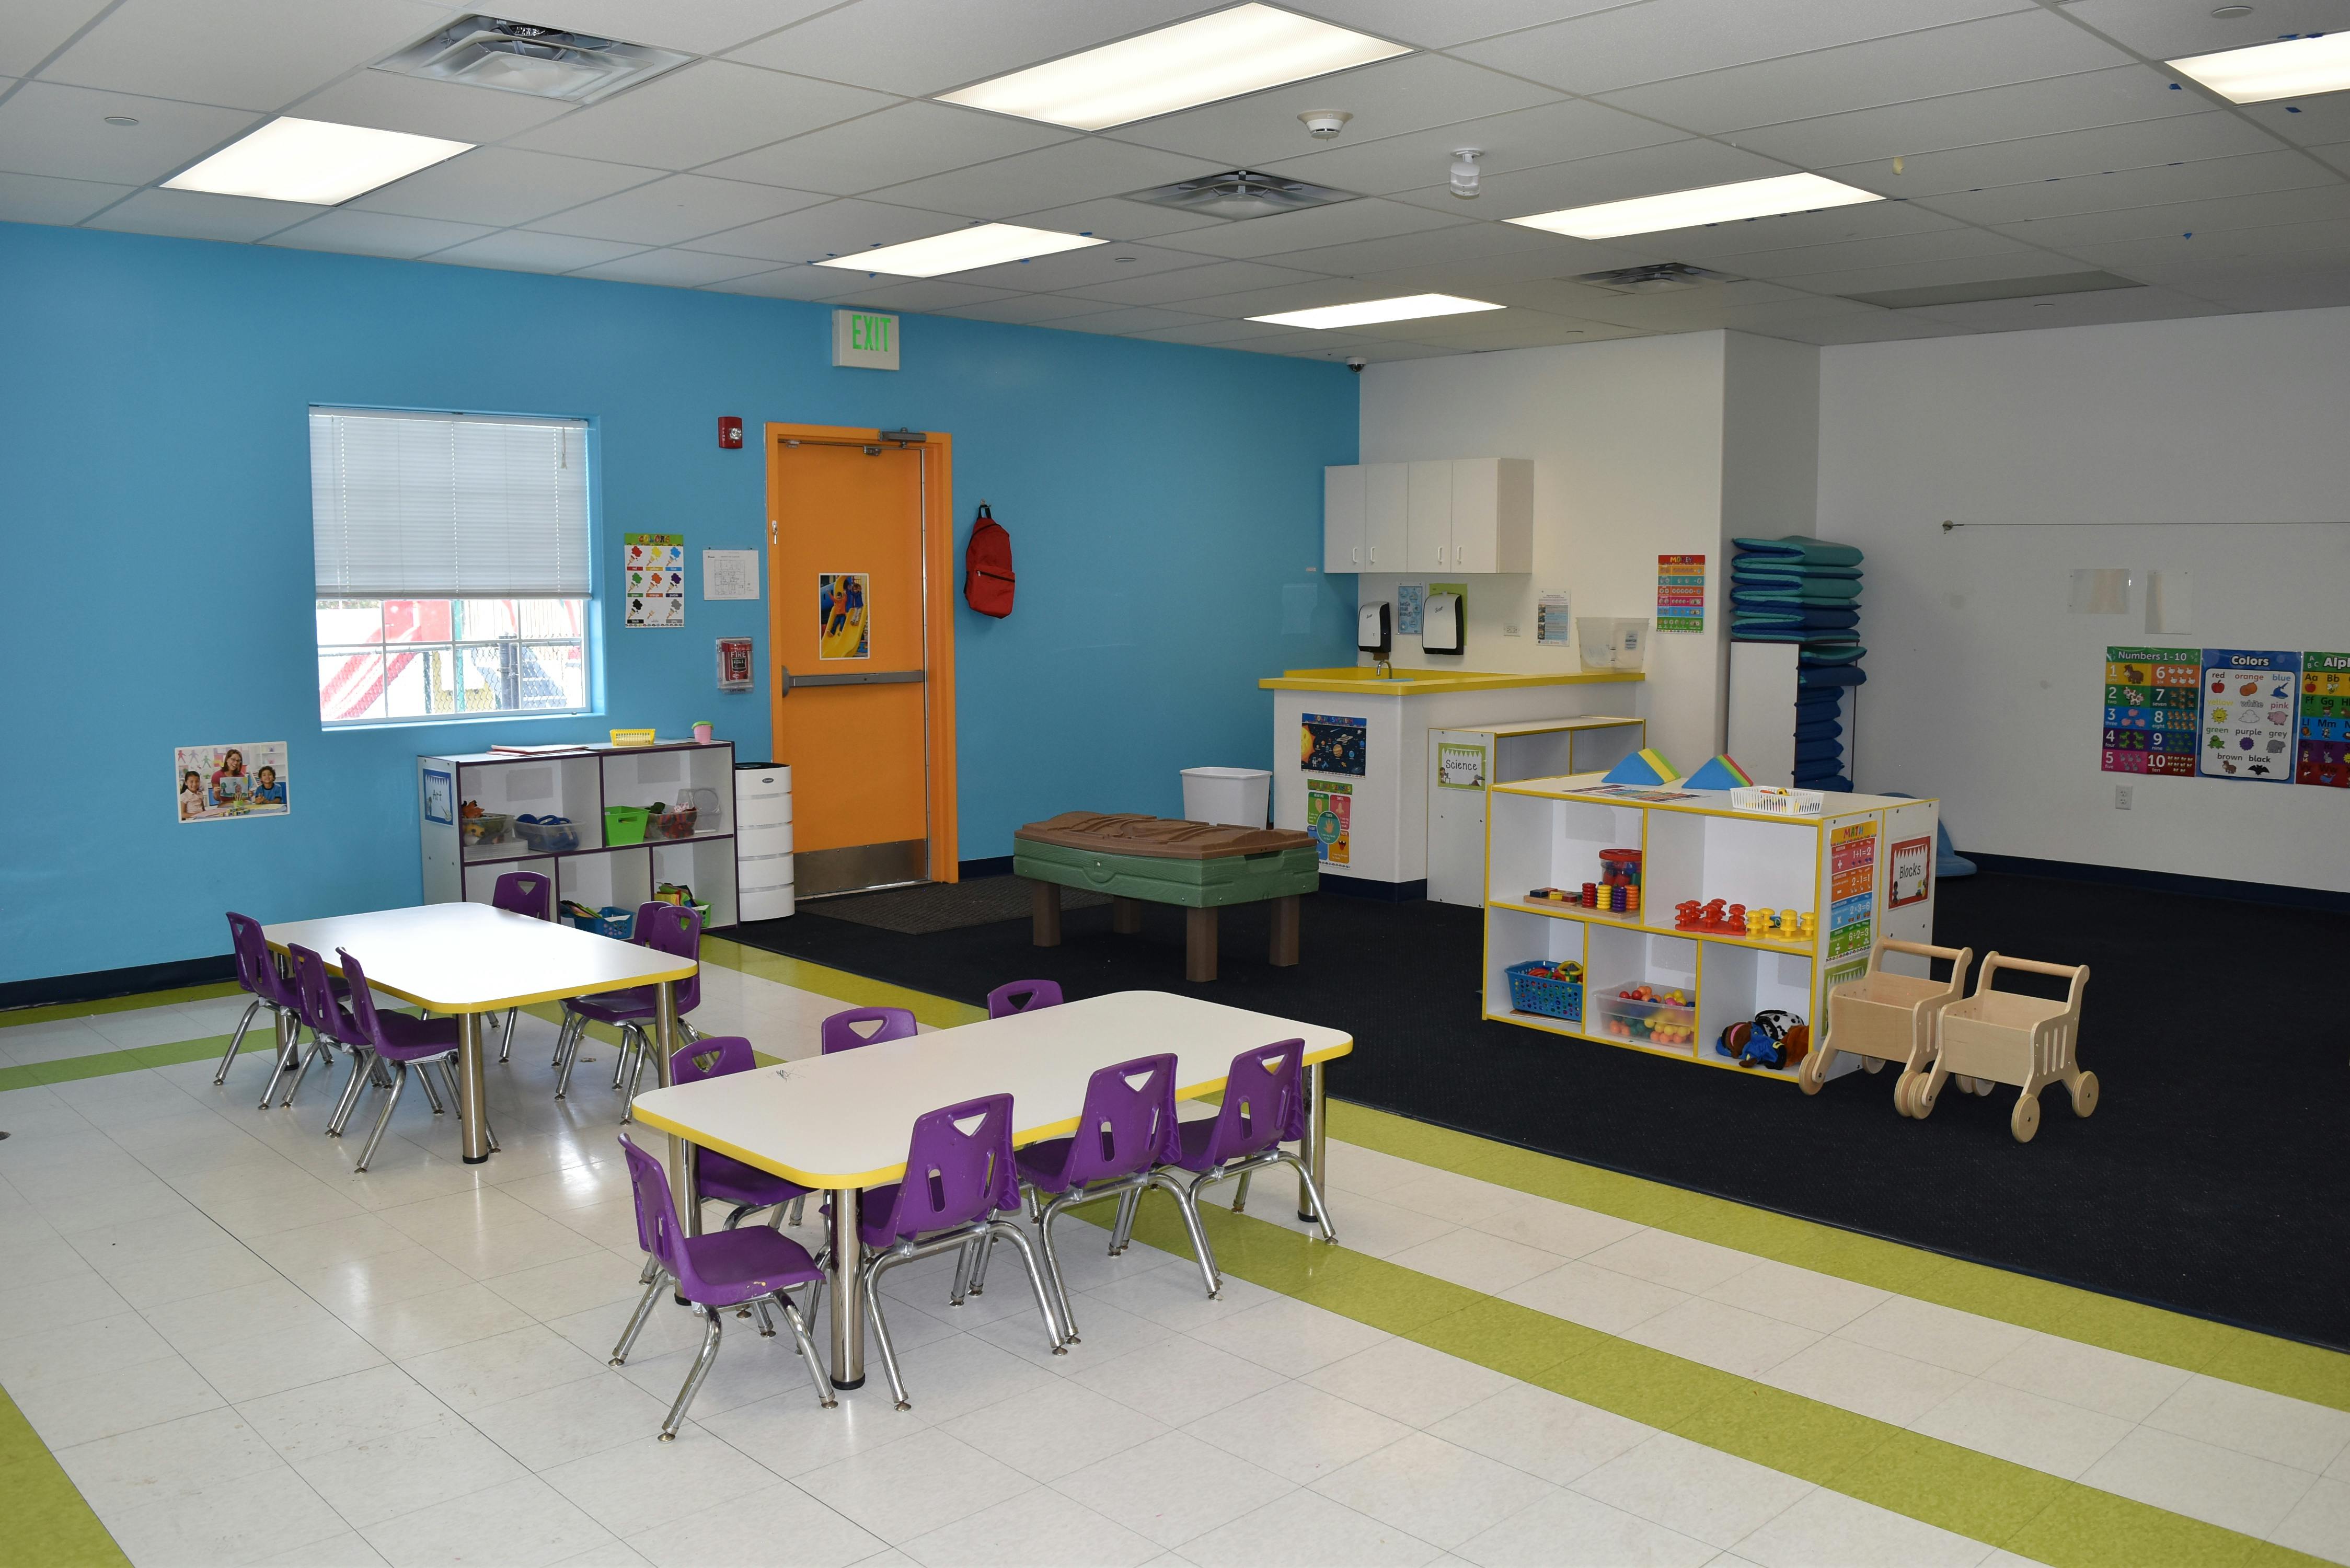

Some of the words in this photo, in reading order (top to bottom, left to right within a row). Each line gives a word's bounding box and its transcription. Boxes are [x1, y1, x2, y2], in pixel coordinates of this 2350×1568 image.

[852, 314, 891, 352] EXIT
[638, 535, 670, 544] COLORS
[2118, 651, 2160, 661] Numbers
[2231, 655, 2269, 666] Colors
[2110, 665, 2117, 677] 1
[2156, 666, 2165, 679] 6
[2234, 673, 2264, 682] orange
[2305, 673, 2318, 682] Aa
[2109, 687, 2116, 699] 2
[2156, 688, 2165, 701] 7
[2305, 696, 2314, 705] Ff
[2321, 697, 2334, 707] Gg
[2107, 708, 2115, 720] 3
[2155, 710, 2163, 723] 8
[2318, 719, 2336, 728] Mm
[2106, 730, 2115, 742] 4
[2153, 733, 2162, 745] 9
[2105, 752, 2114, 764] 5
[2148, 754, 2165, 767] 10
[2217, 753, 2242, 761] brown
[2249, 755, 2271, 763] black
[1446, 759, 1477, 770] Science
[433, 789, 442, 801] Art
[1844, 825, 1863, 839] MATH
[1899, 862, 1921, 879] Blocks
